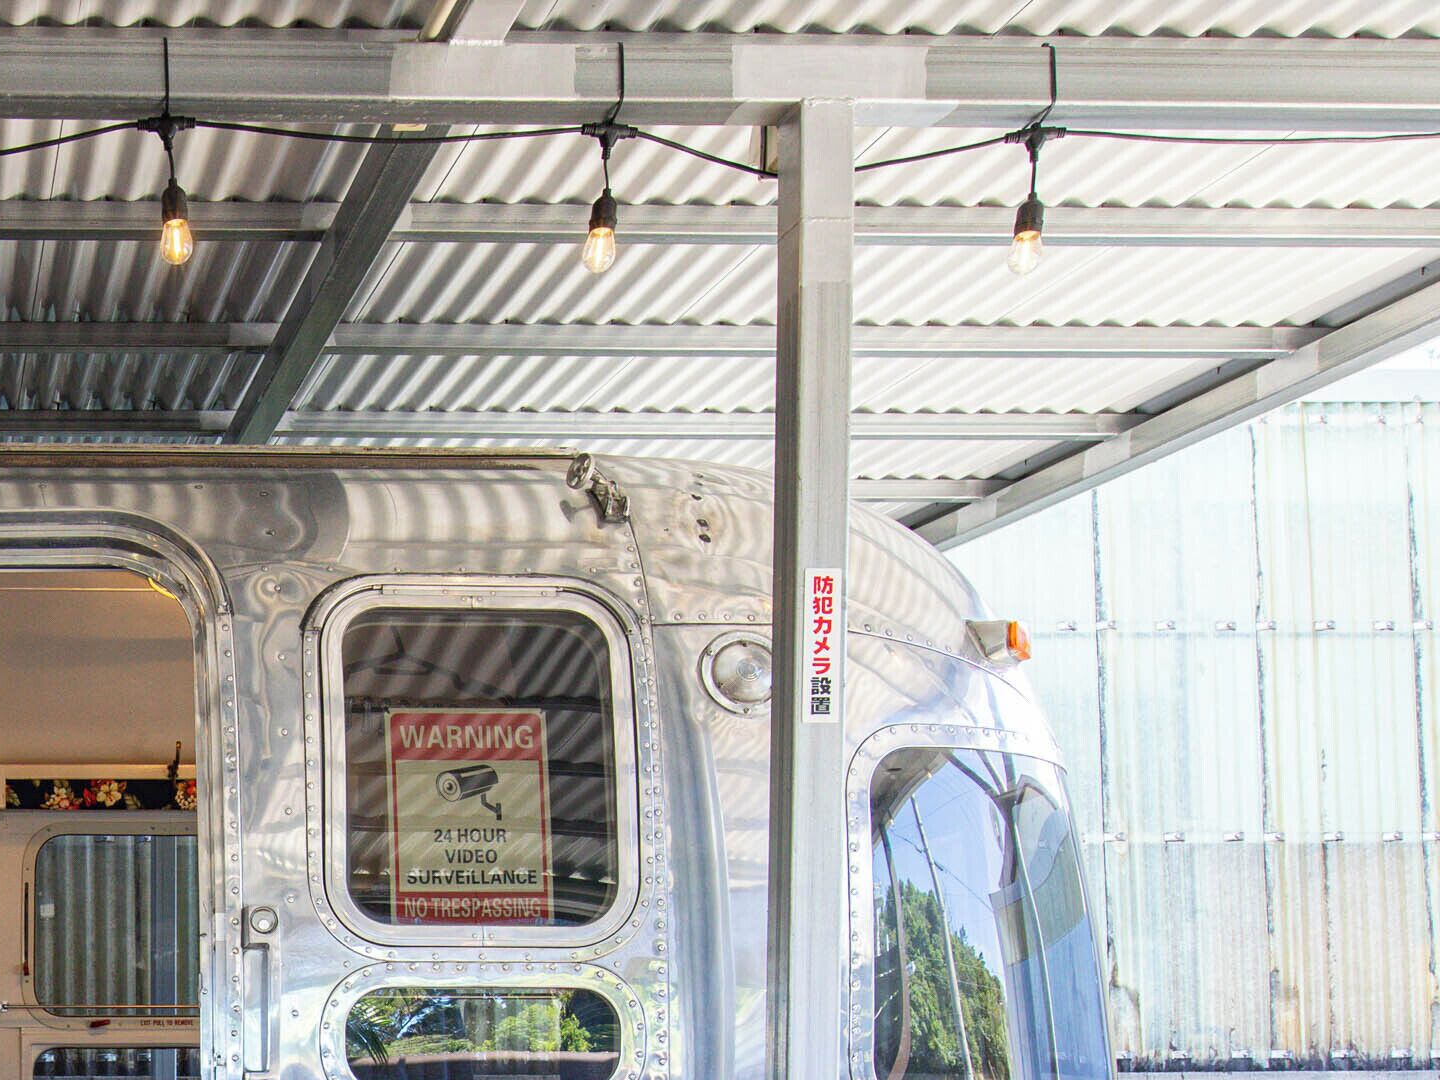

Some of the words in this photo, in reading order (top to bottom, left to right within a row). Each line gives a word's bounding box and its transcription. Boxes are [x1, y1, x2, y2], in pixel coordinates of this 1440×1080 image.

[810, 575, 834, 715] 防犯カメラ設置
[399, 725, 534, 749] WARNING
[433, 829, 452, 843] 24
[457, 828, 507, 843] HOUR
[444, 849, 498, 864] VIDEO
[407, 869, 538, 885] SURVEILLANCE
[404, 898, 428, 917] NO
[432, 897, 542, 918] TRESPASSING
